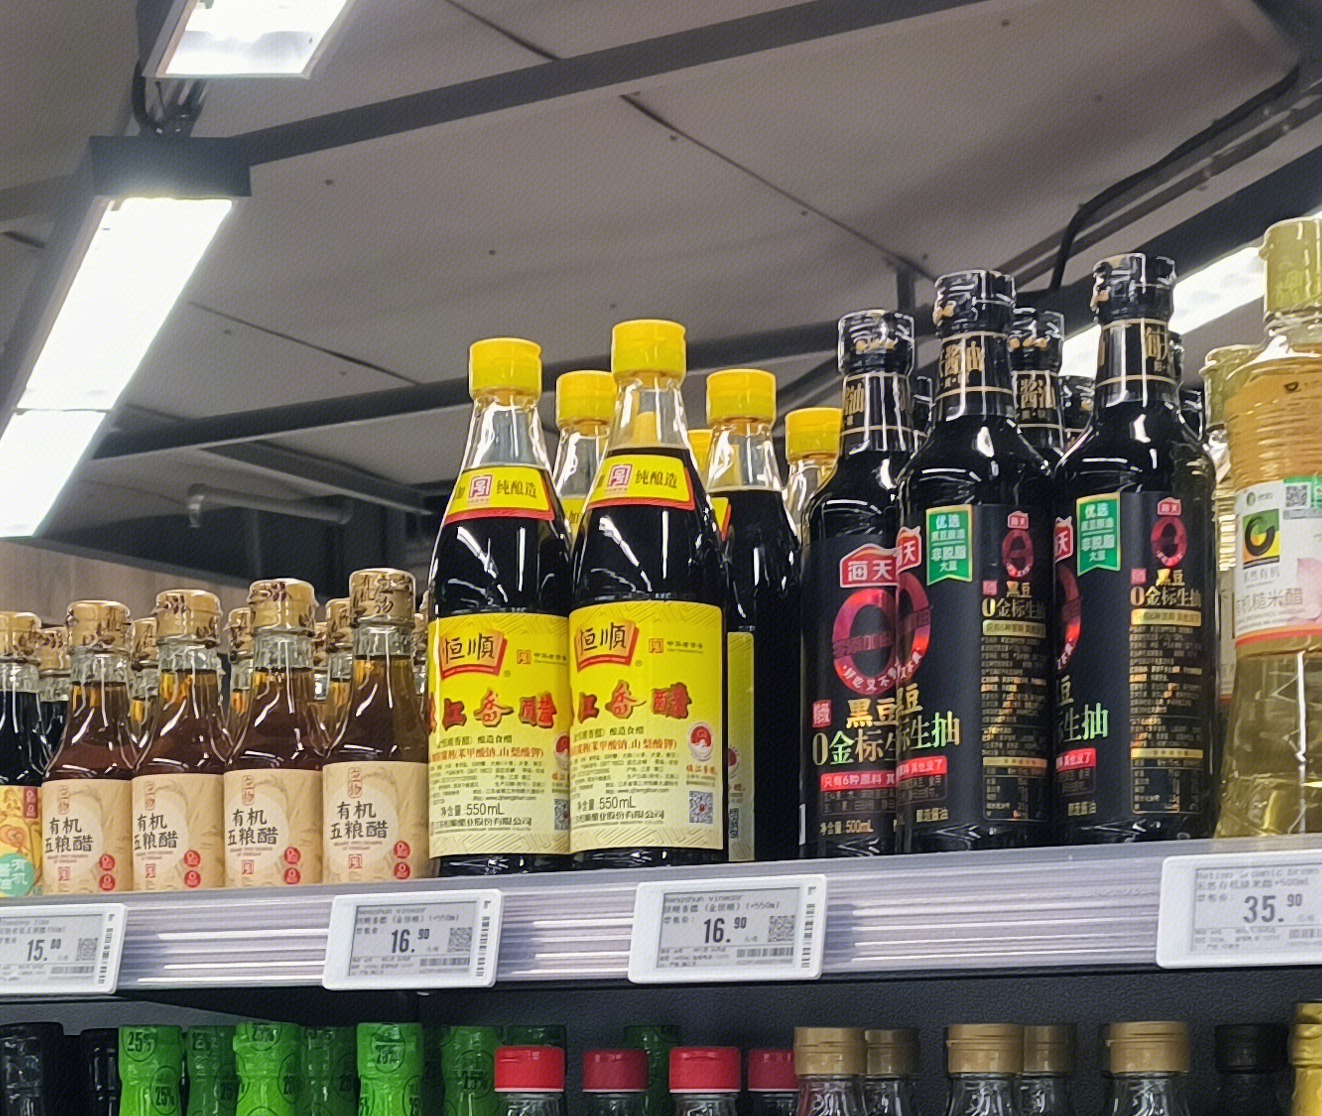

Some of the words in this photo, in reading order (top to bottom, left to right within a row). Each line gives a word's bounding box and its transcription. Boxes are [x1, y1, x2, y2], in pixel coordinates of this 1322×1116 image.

[635, 470, 677, 489] 纯酿造
[496, 481, 537, 499] 纯酿造
[846, 558, 894, 583] 海天
[429, 688, 558, 732] 江香醋
[233, 808, 267, 828] 有机
[337, 801, 376, 820] 有机
[49, 818, 82, 834] 有机
[136, 814, 168, 832] 有机
[330, 820, 389, 841] 五粮醋
[44, 834, 95, 853] 五粮醋
[227, 826, 279, 846] 五粮醋
[1243, 893, 1303, 923] 35.90
[703, 916, 748, 945] 16.90
[391, 927, 430, 955] 16.90
